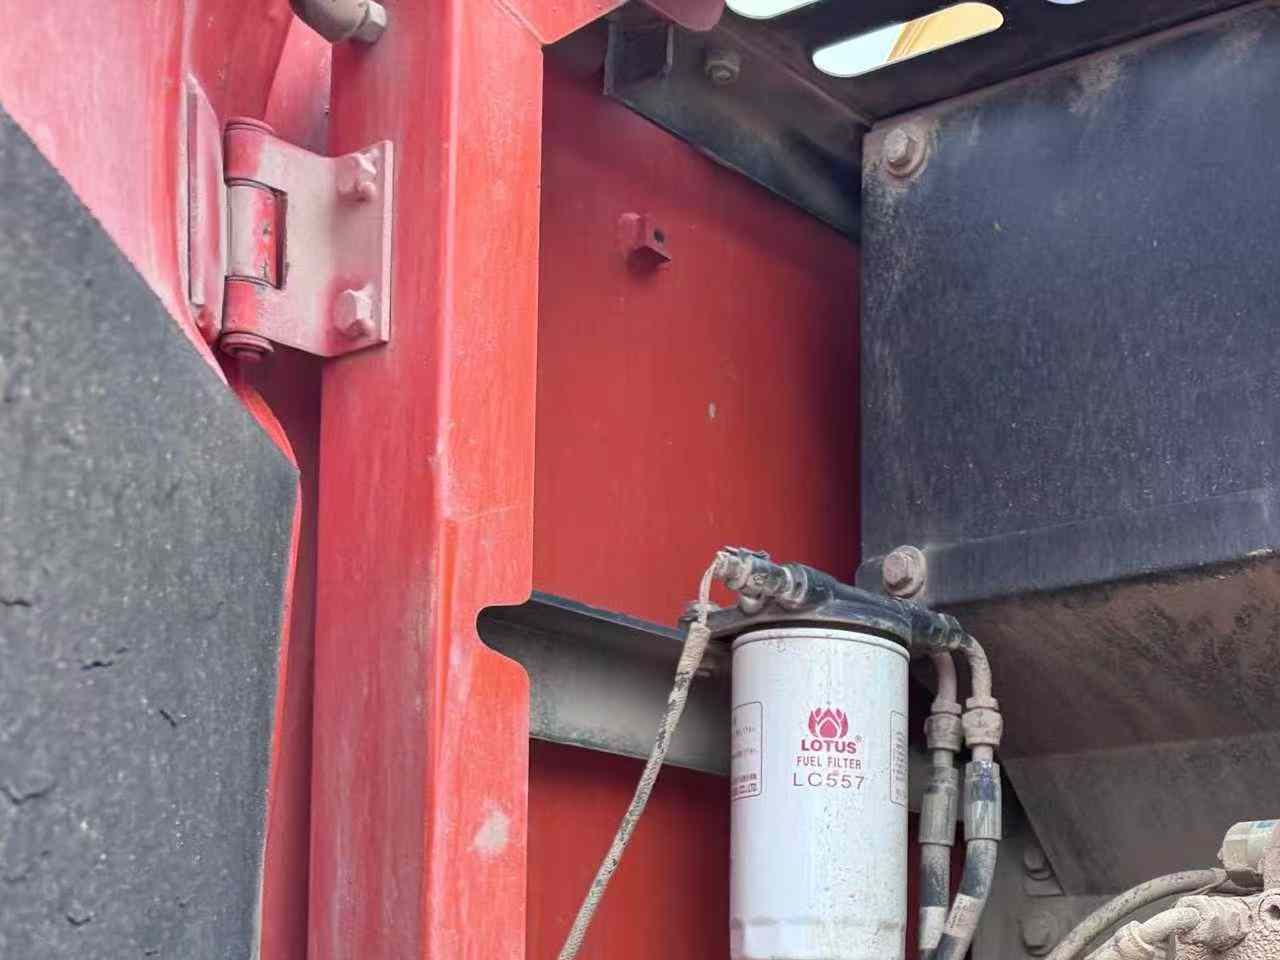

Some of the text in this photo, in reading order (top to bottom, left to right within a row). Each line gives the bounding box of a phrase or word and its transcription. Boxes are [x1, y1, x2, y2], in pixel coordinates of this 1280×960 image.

[801, 738, 857, 754] LOTUS
[796, 755, 862, 770] FUEL FILTER
[793, 772, 865, 790] LC557
